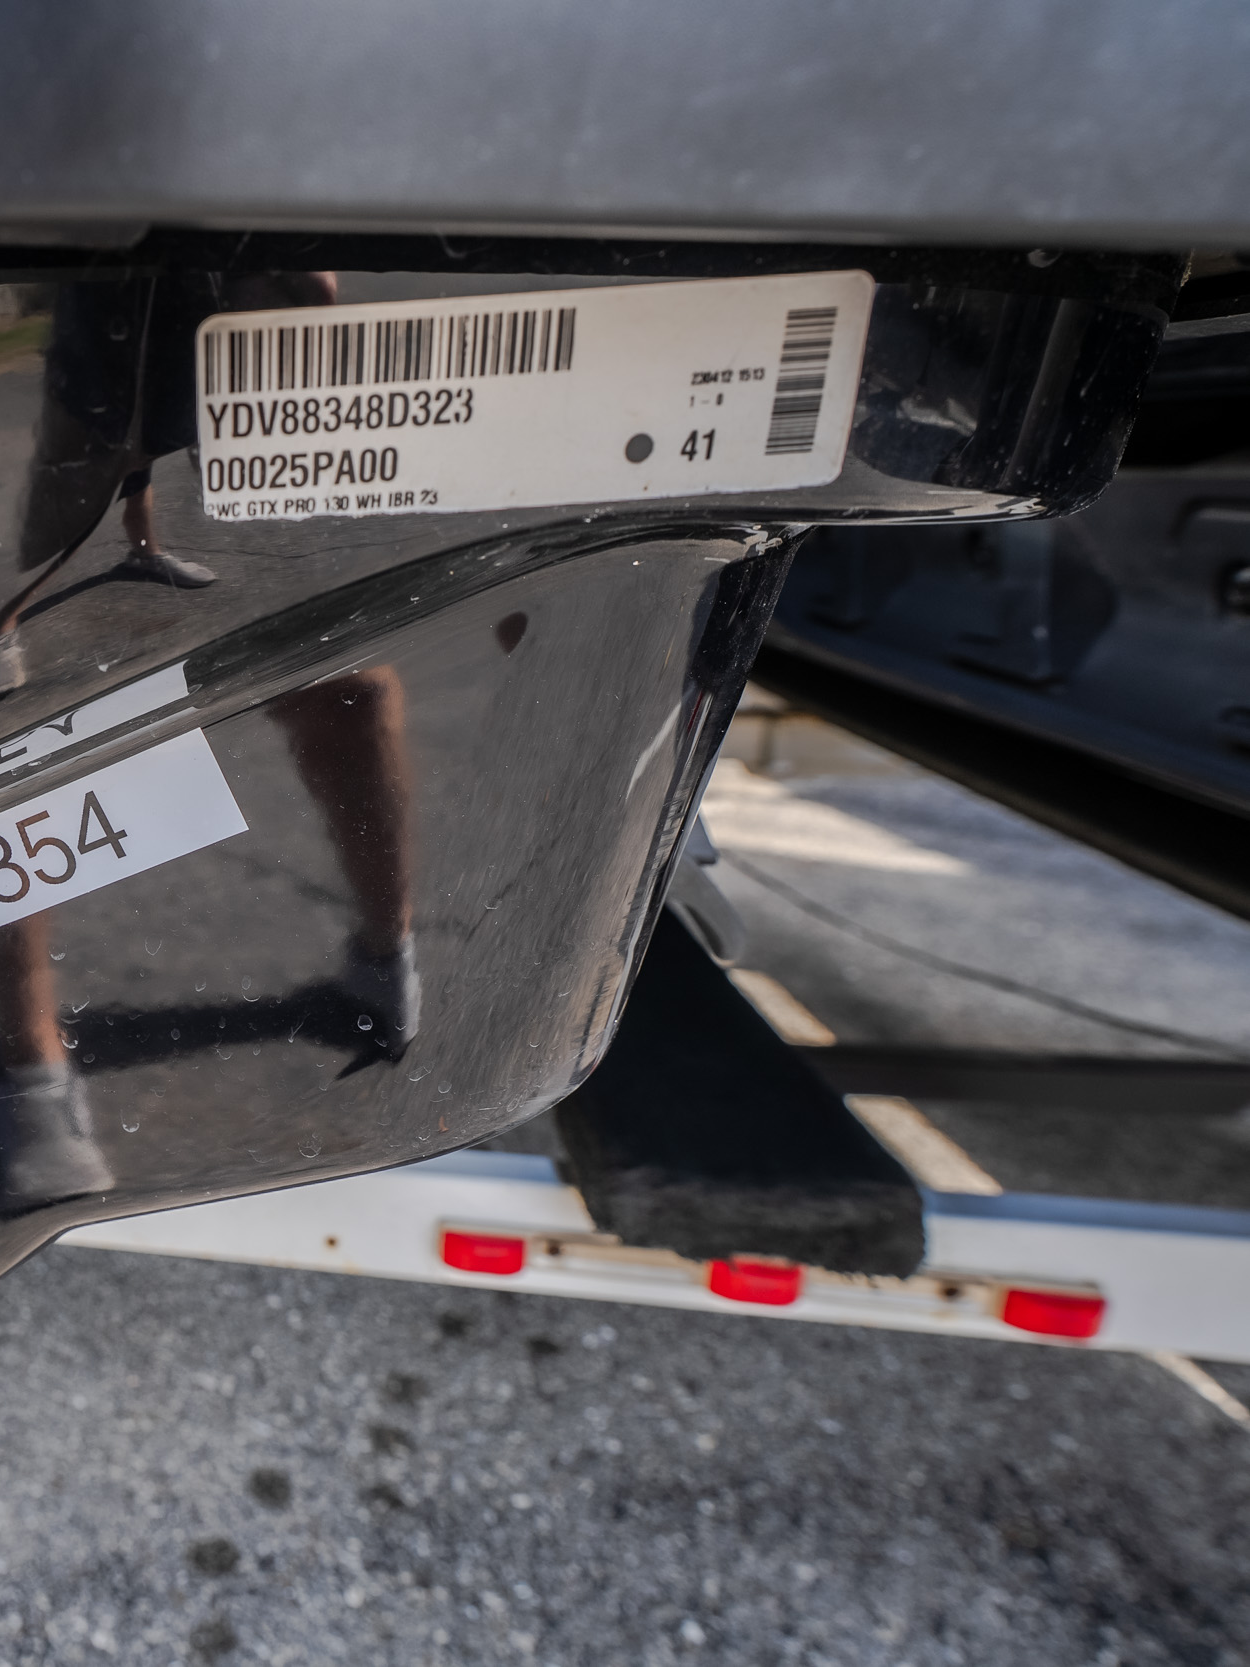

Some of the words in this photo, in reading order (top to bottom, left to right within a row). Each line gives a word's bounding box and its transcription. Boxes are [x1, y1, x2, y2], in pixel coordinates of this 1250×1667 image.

[207, 388, 473, 440] YDV88348D323
[680, 428, 716, 462] 41
[207, 447, 398, 492] 00025PA00
[247, 500, 279, 517] GTX
[284, 498, 317, 514] PRO
[356, 494, 382, 510] WH
[389, 491, 415, 507] IBR
